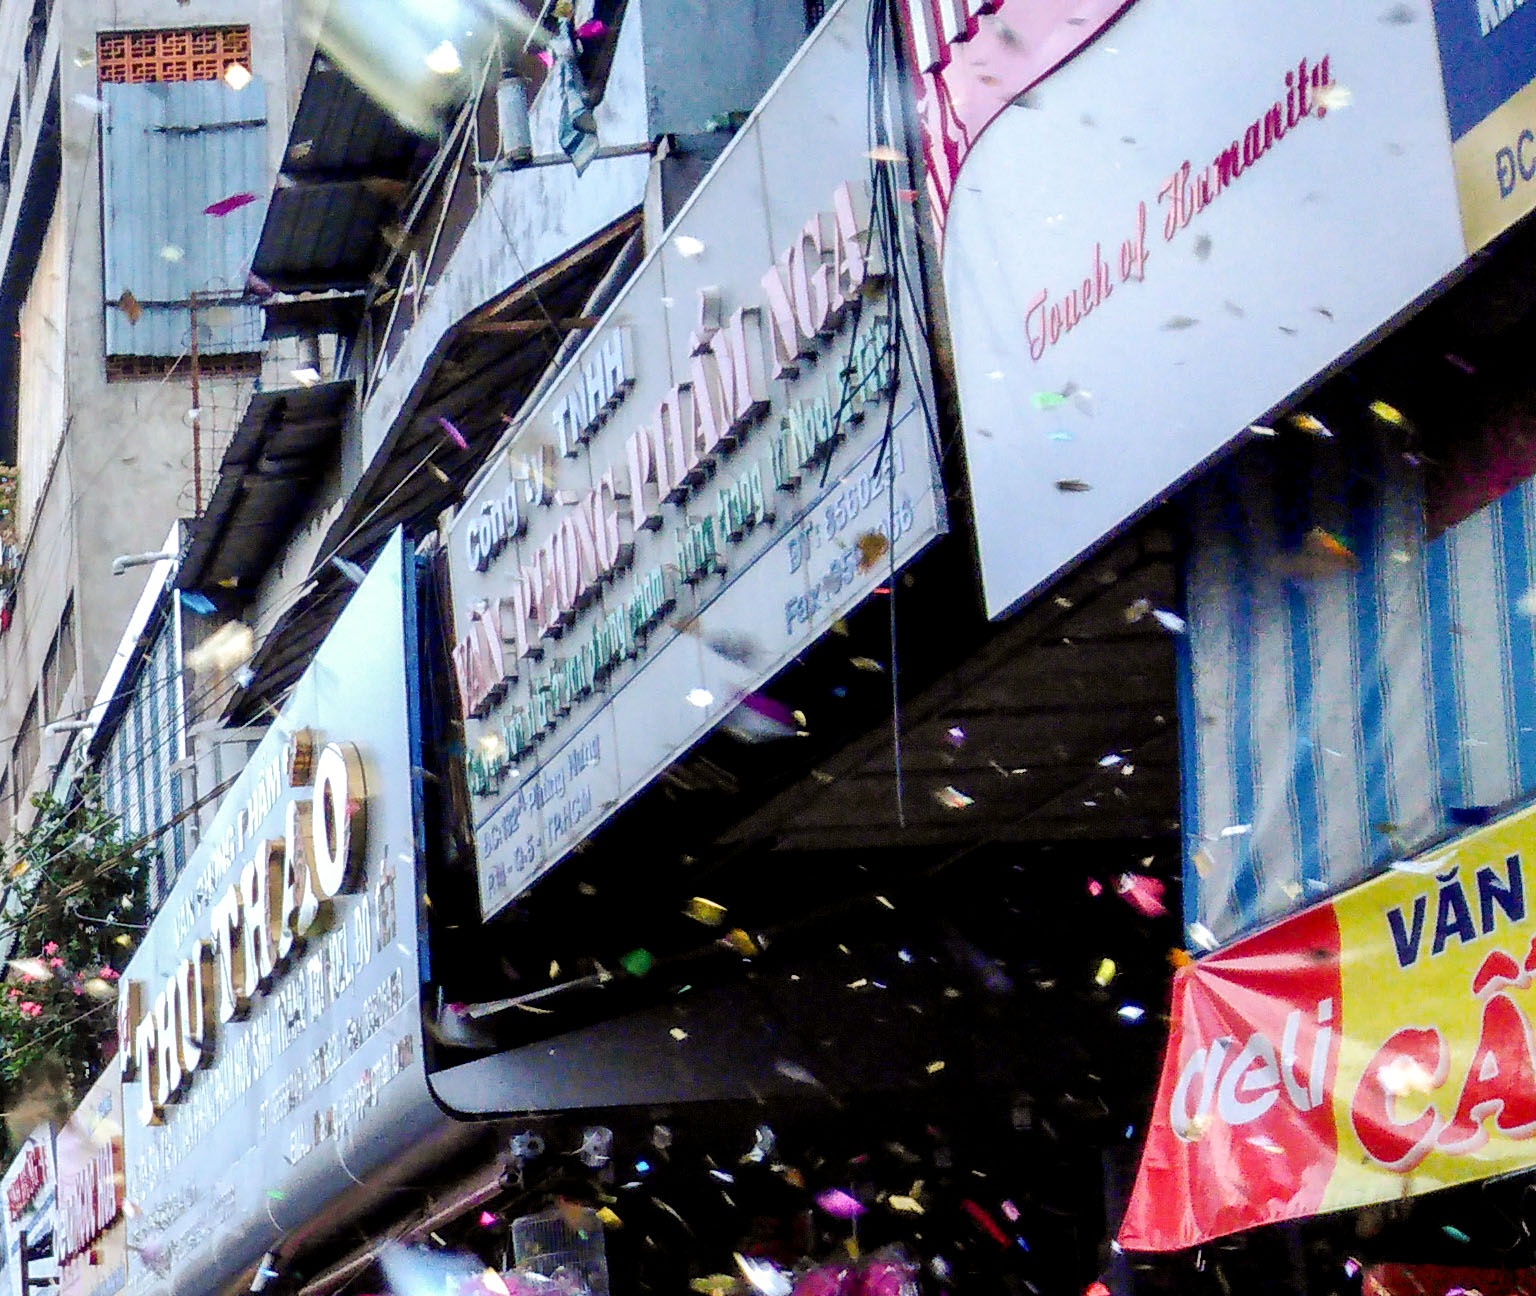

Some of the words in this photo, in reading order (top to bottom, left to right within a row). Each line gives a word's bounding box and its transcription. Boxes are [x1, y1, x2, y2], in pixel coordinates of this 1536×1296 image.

[761, 180, 870, 380] NGA
[1025, 243, 1112, 361] Touch
[1118, 200, 1149, 283] of
[466, 485, 520, 572] Công
[552, 326, 629, 457] TNHH
[1387, 855, 1525, 968] VĂN
[1171, 998, 1333, 1141] deli
